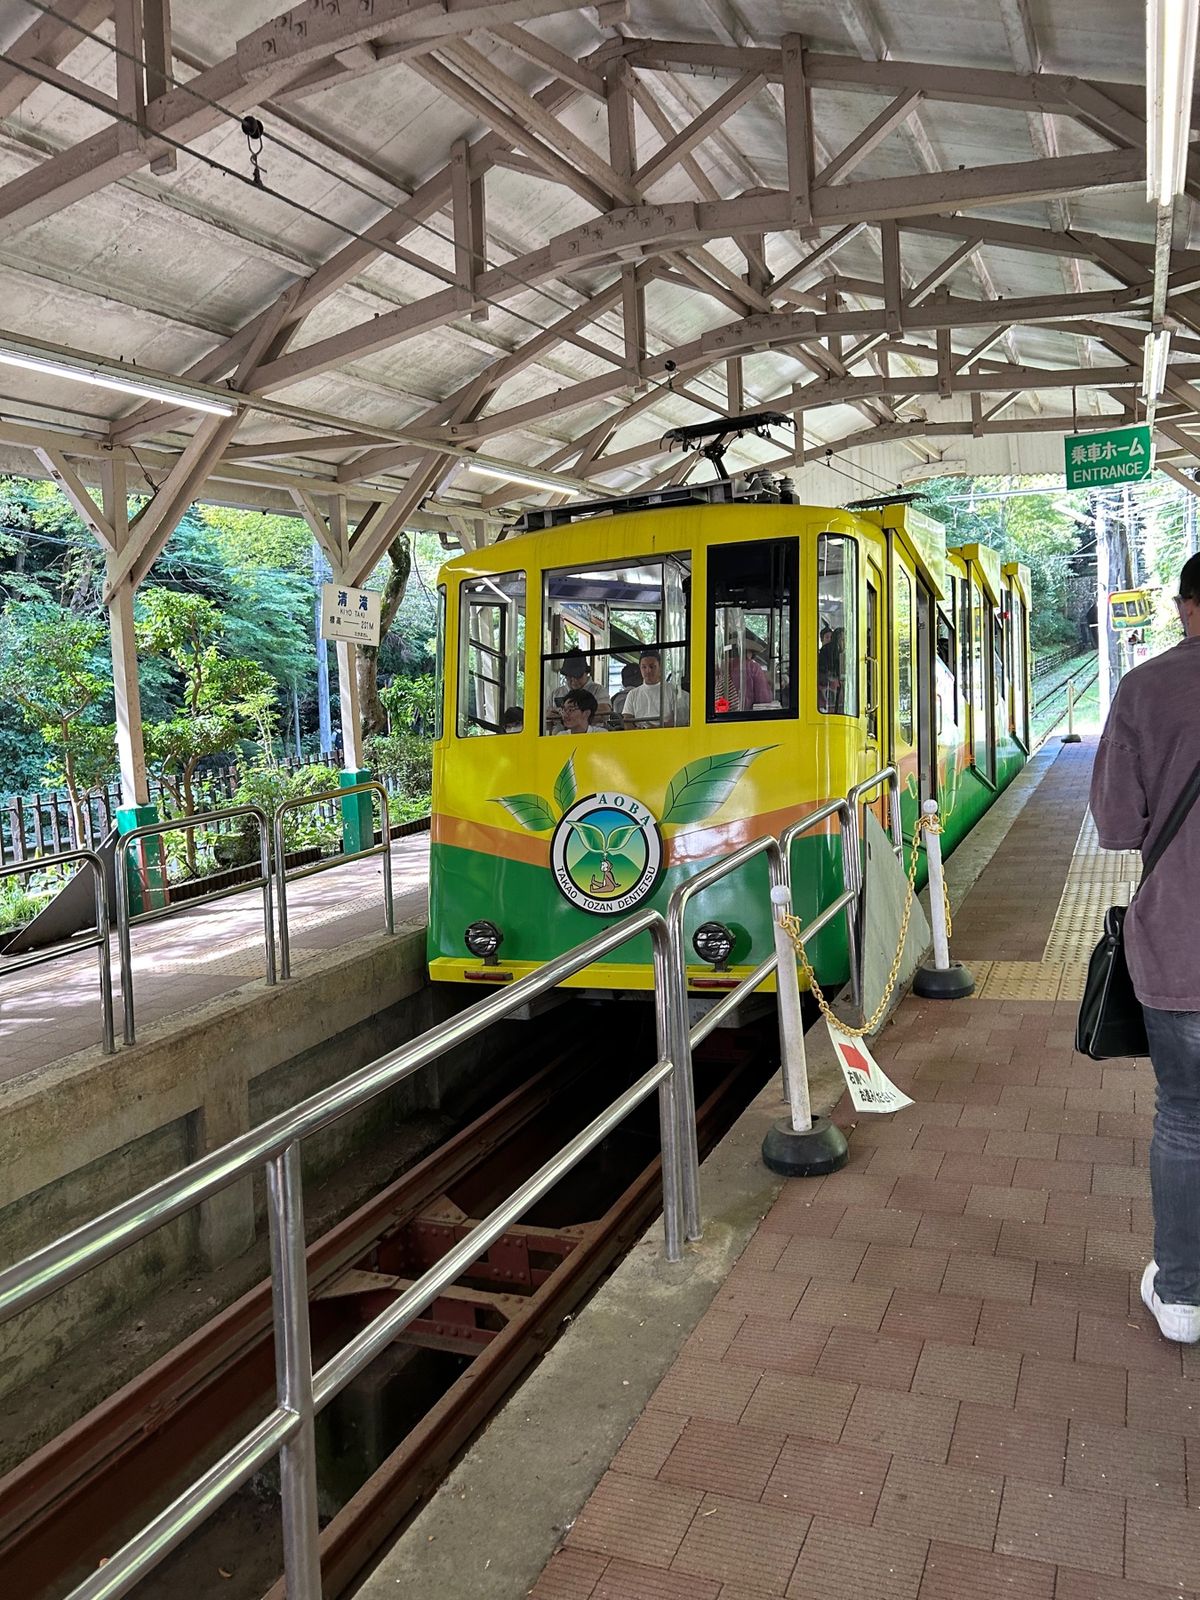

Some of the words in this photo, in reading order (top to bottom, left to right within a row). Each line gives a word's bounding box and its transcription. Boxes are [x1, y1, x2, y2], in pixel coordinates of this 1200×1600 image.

[1071, 437, 1144, 465] 乗車ホーム
[1073, 461, 1144, 483] ENTRANCE
[598, 794, 651, 827] AOBA
[556, 865, 578, 899] TAKAO
[582, 898, 613, 911] TOZAN
[618, 866, 656, 909] DENTETSU
